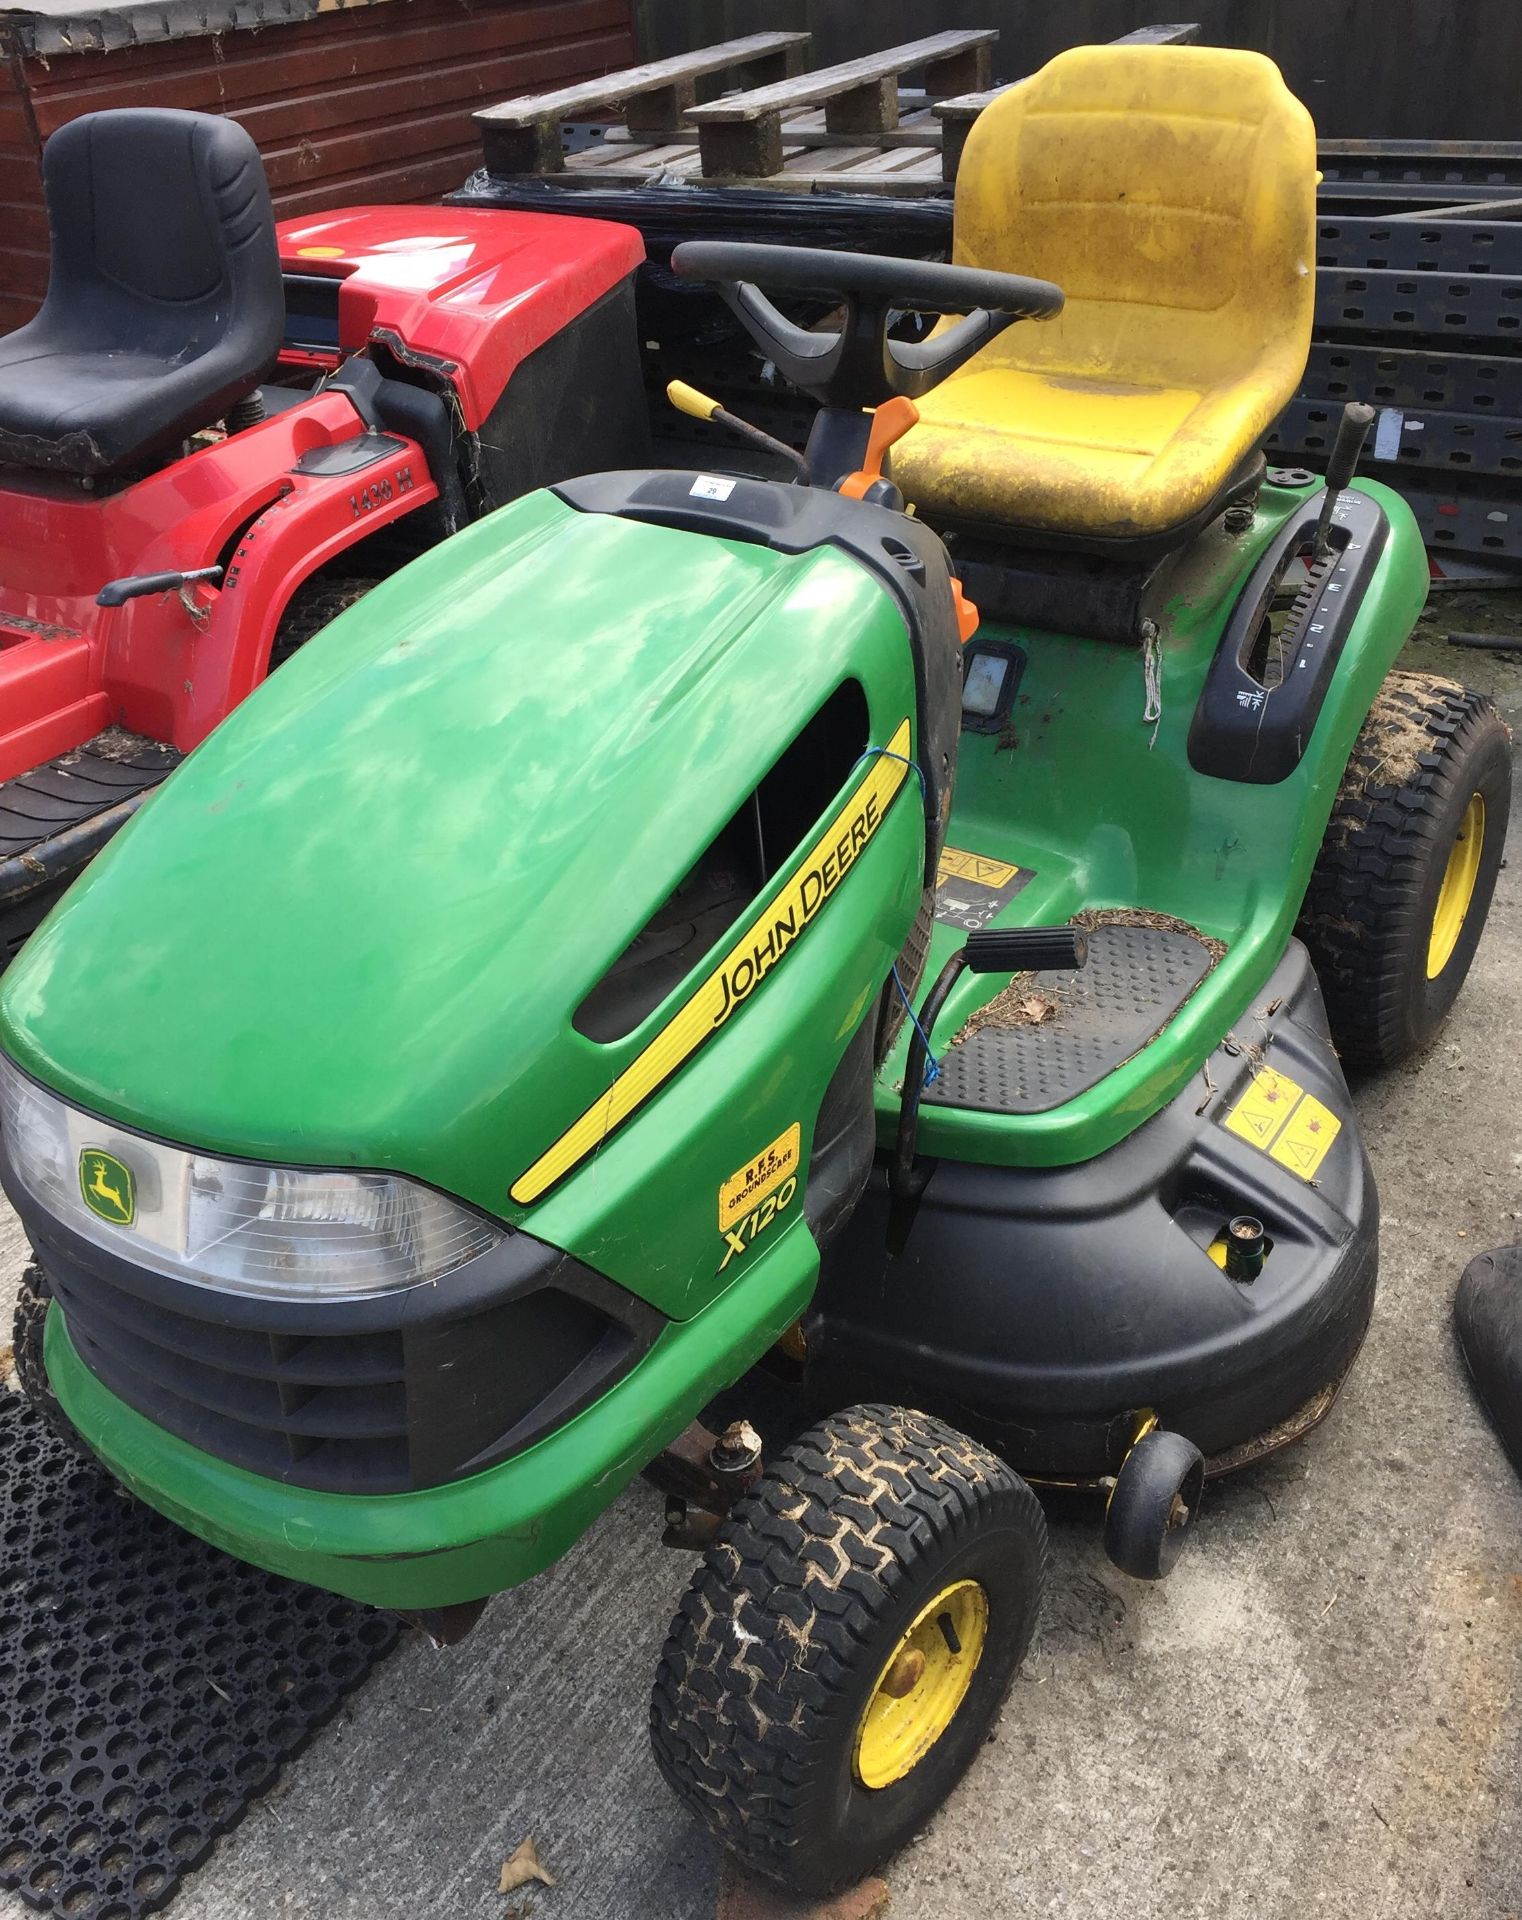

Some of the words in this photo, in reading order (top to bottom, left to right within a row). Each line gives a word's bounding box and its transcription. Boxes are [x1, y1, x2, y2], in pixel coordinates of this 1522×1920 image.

[349, 478, 393, 517] 1430
[395, 466, 414, 493] H
[713, 905, 796, 1024] JOHN
[800, 792, 880, 919] DEERE
[728, 1149, 792, 1209] GROUNDSCARE
[745, 1150, 778, 1185] R.F.S.
[717, 1176, 797, 1272] X120
